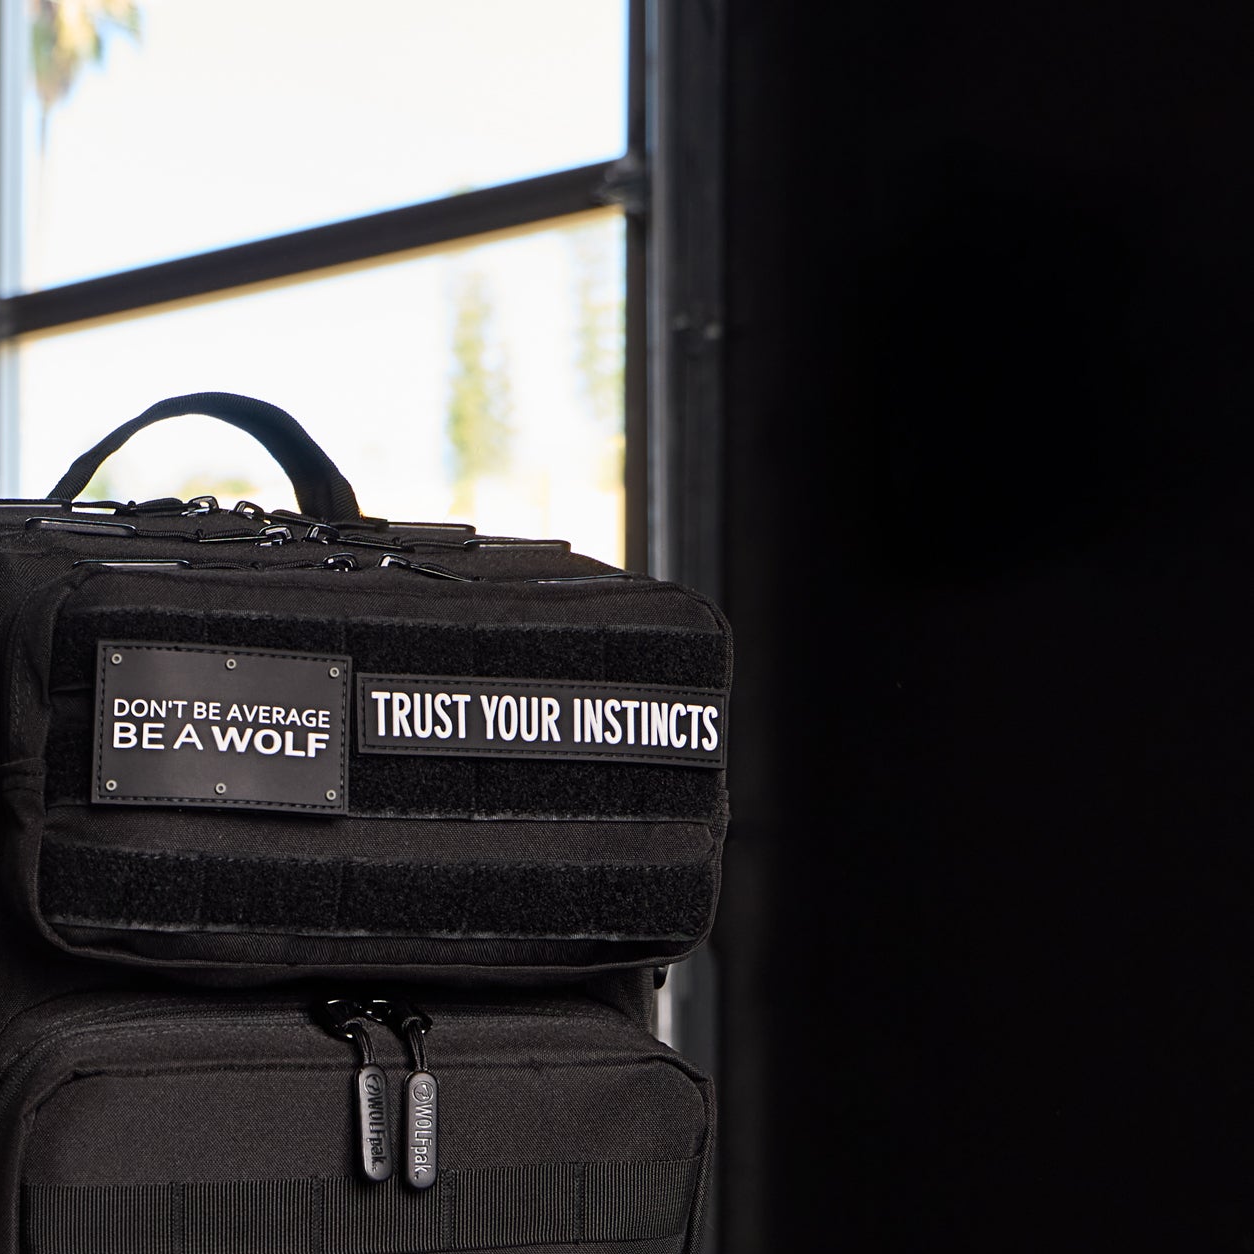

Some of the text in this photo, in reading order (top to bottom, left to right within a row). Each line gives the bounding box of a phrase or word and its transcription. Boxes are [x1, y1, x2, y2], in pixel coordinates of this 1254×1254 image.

[113, 698, 331, 729] DON'T BE AVERAGE
[370, 690, 719, 752] TRUST YOUR INSTINCTS
[112, 721, 330, 758] BE A WOLF
[411, 1103, 432, 1173] WOLFpak
